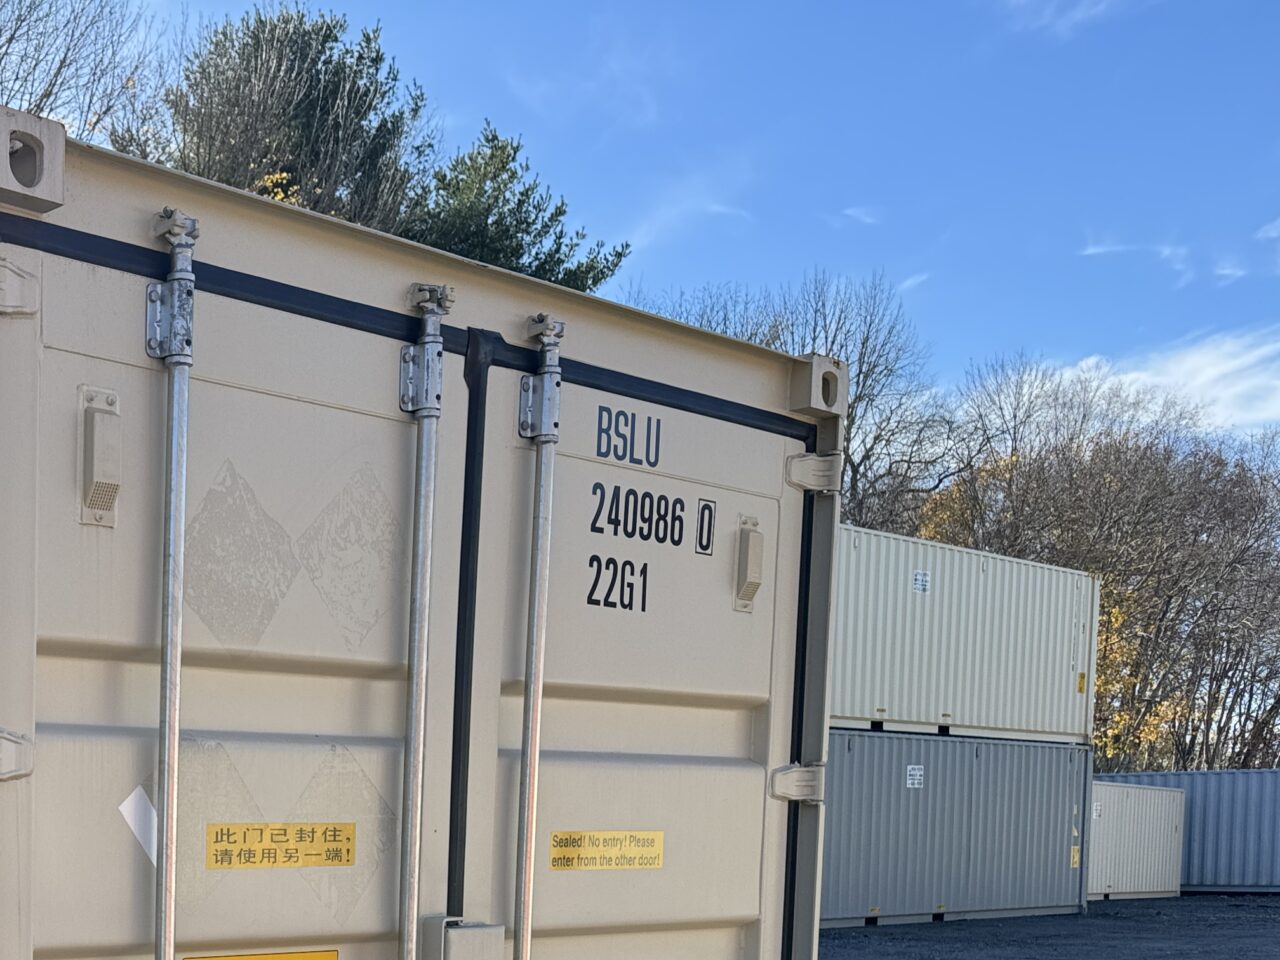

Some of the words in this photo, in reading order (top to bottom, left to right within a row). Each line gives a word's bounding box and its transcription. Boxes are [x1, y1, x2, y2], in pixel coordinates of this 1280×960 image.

[596, 404, 661, 467] BSLU
[590, 482, 685, 546] 240986
[698, 502, 713, 552] 0
[587, 554, 648, 613] 22G1
[551, 855, 575, 867] enter
[577, 854, 597, 867] from
[599, 853, 613, 867] the
[614, 854, 636, 867] other
[637, 853, 660, 866] door!
[552, 834, 586, 848] Sealed!
[588, 834, 600, 848] No
[602, 834, 627, 851] entry!
[628, 834, 656, 848] Please
